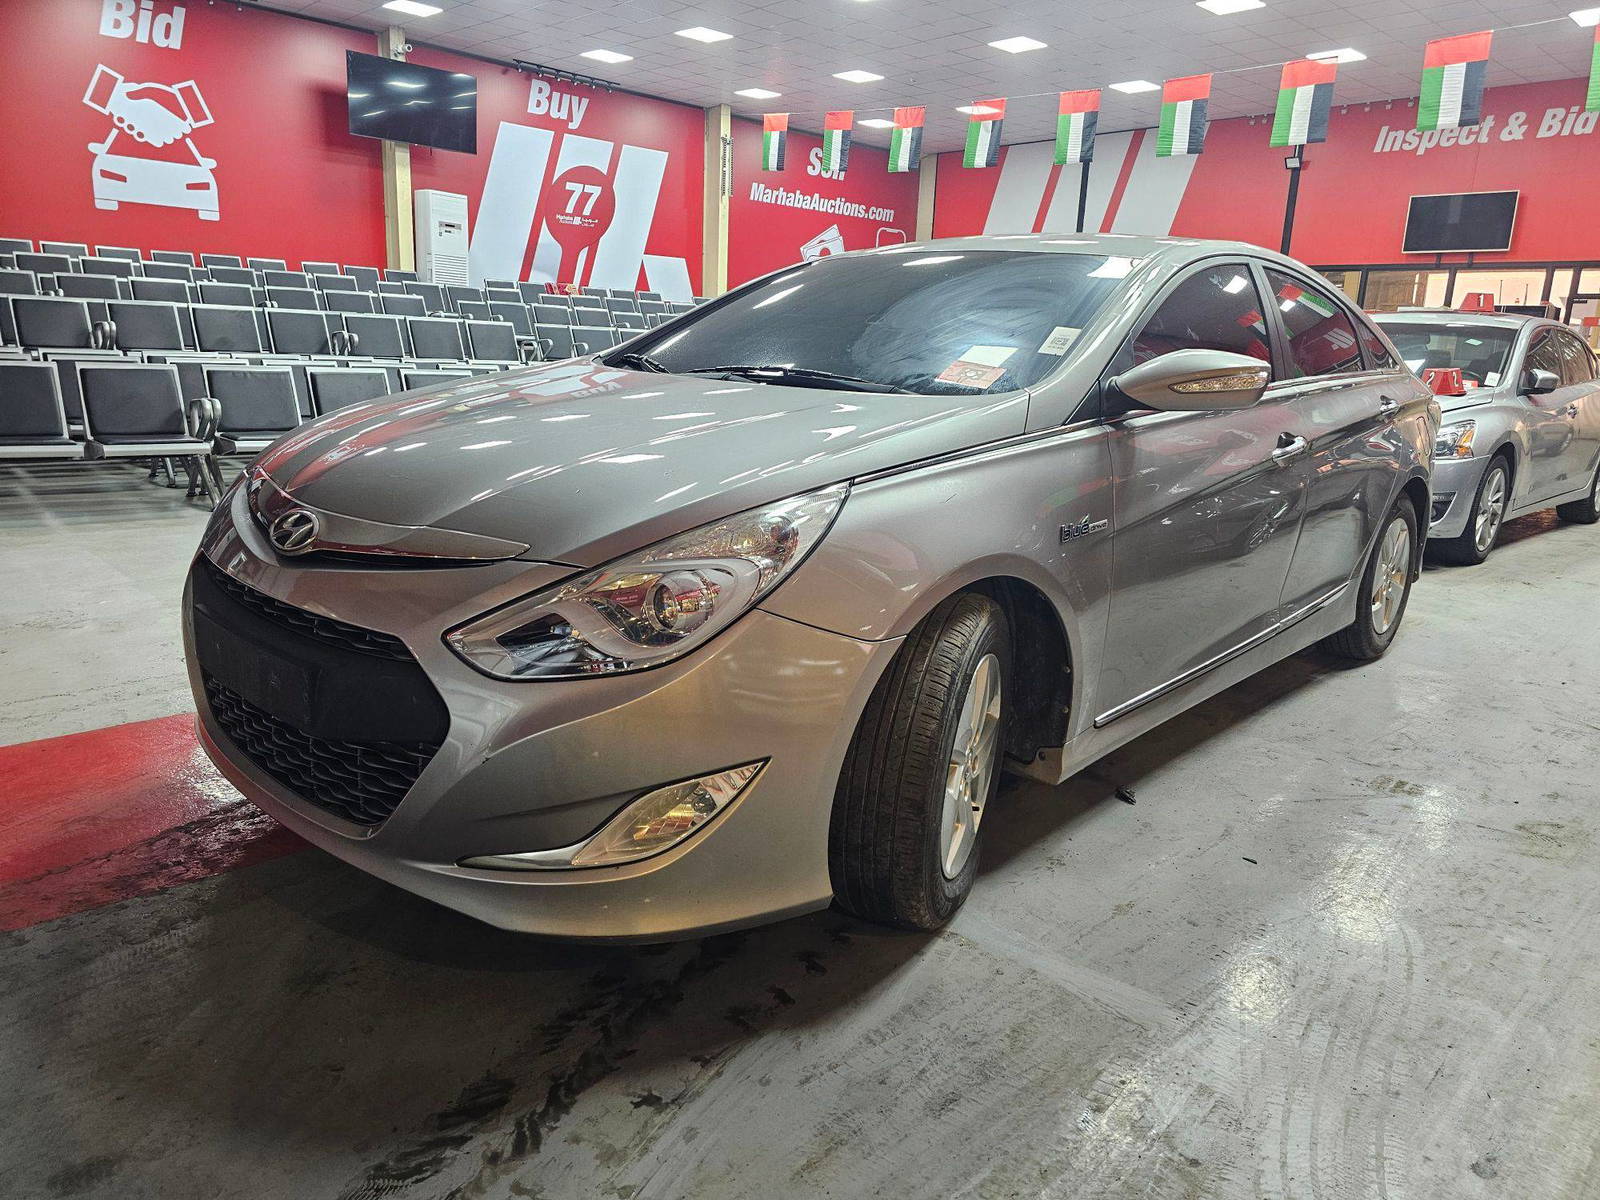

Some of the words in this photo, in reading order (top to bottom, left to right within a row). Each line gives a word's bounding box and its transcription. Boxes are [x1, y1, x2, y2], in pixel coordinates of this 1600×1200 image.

[99, 0, 186, 50] Bid
[527, 79, 590, 130] Buy
[1373, 115, 1495, 155] Inspect
[1500, 111, 1528, 142] &
[565, 181, 603, 216] 77
[750, 182, 895, 222] MarhabaAuctions.com
[1478, 294, 1484, 307] 1
